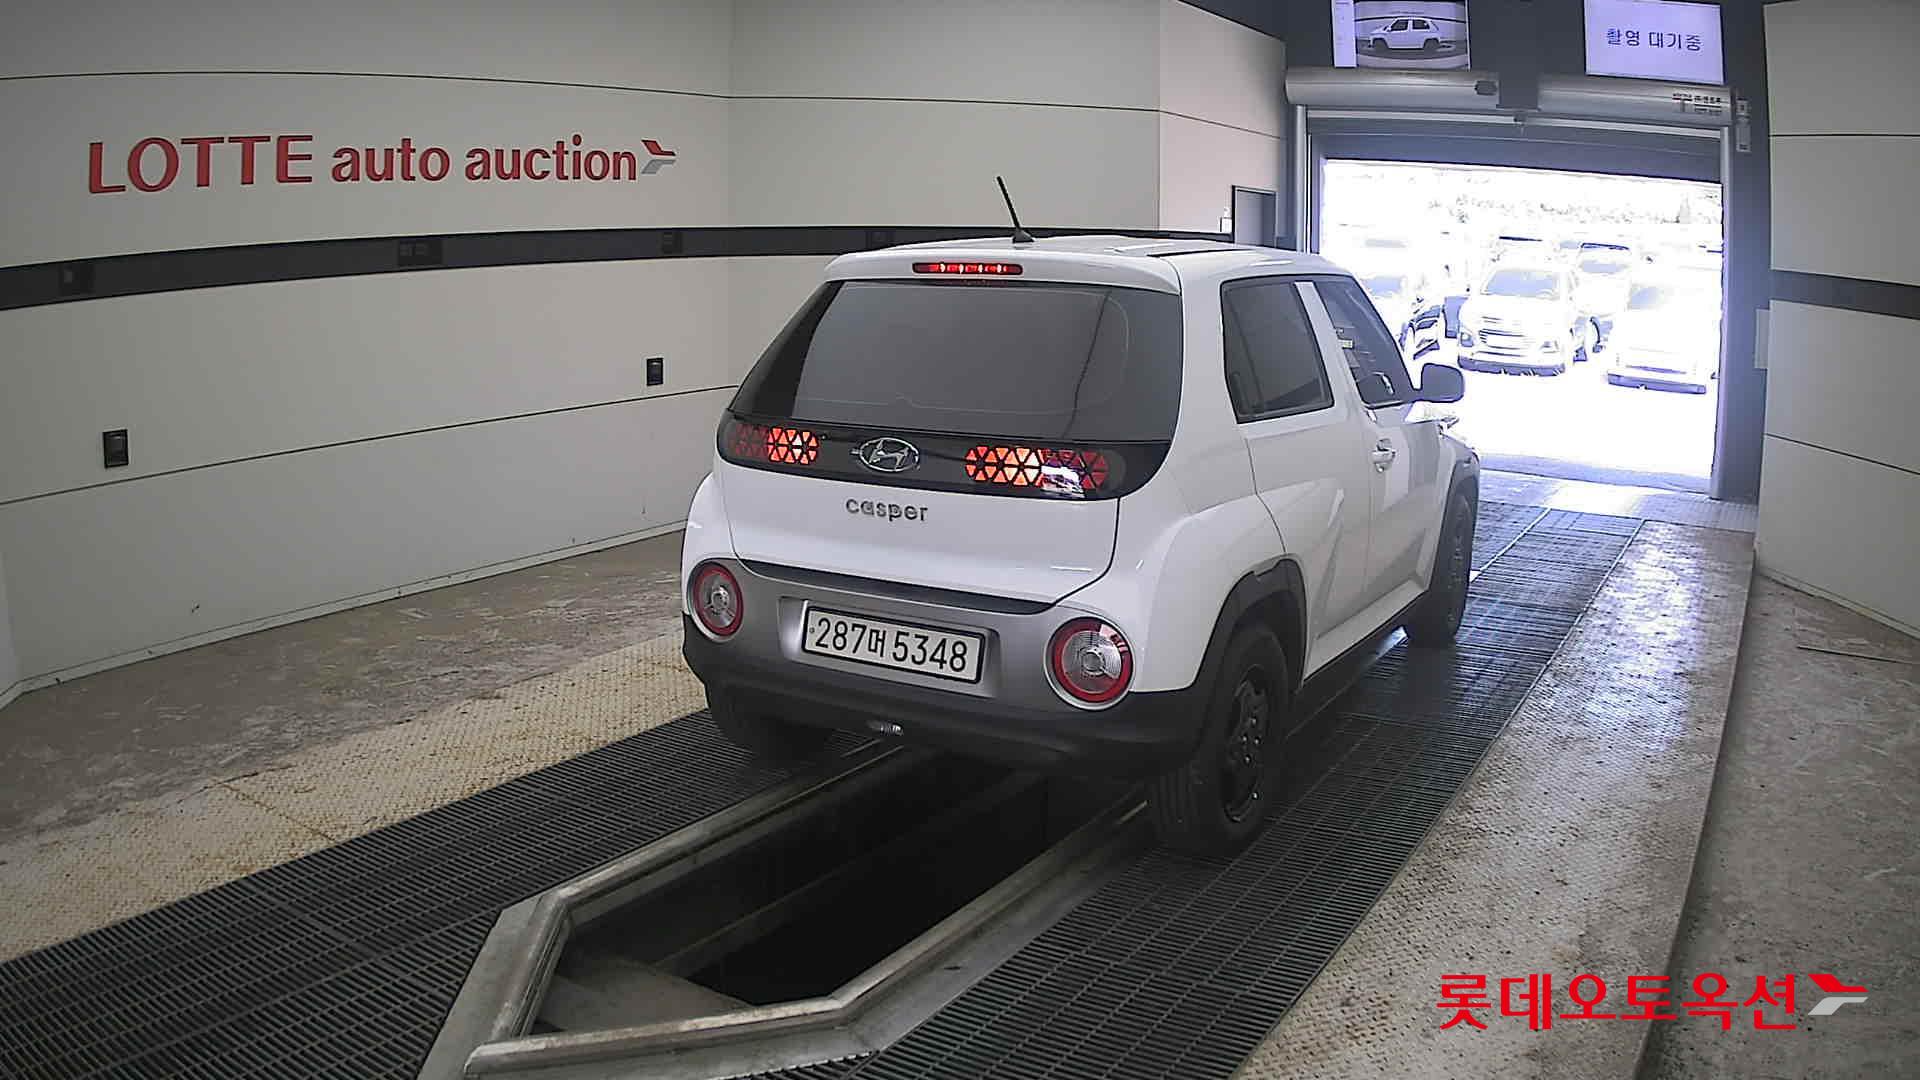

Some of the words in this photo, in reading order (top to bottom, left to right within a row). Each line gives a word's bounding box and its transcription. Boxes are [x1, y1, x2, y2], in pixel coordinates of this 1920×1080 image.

[1648, 31, 1701, 52] 대기중
[88, 134, 313, 195] LOTTE
[331, 137, 450, 182] auto
[464, 134, 637, 182] auction
[846, 498, 928, 521] casper
